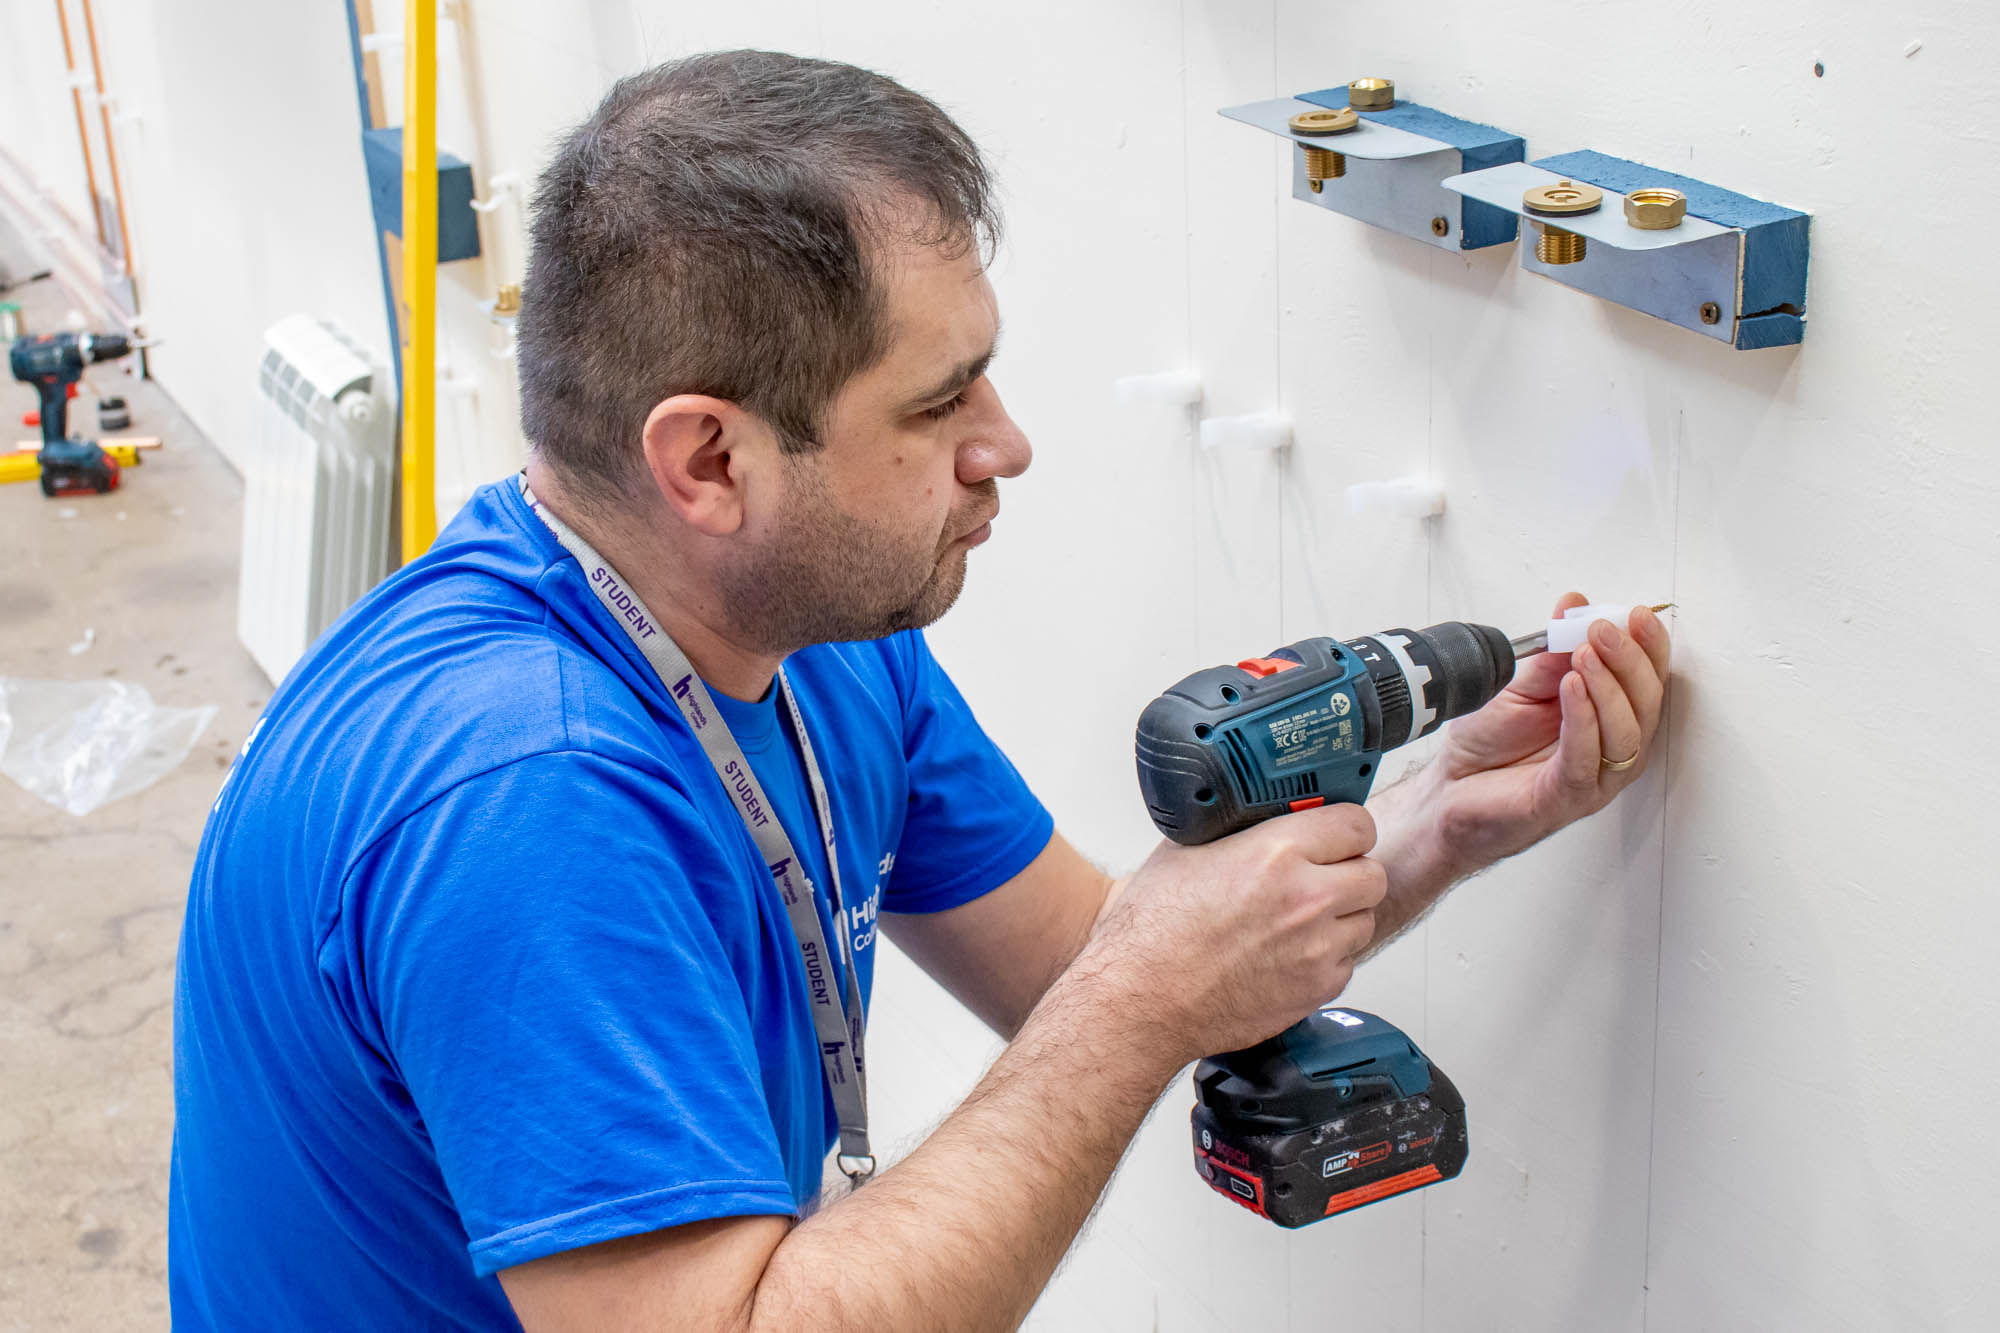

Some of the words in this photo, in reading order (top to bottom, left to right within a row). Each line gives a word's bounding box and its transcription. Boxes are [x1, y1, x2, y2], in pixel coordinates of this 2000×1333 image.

[592, 567, 656, 638] STUDENT
[724, 760, 769, 828] STUDENT
[802, 942, 831, 1006] STUDENT
[1326, 1158, 1348, 1172] AMP
